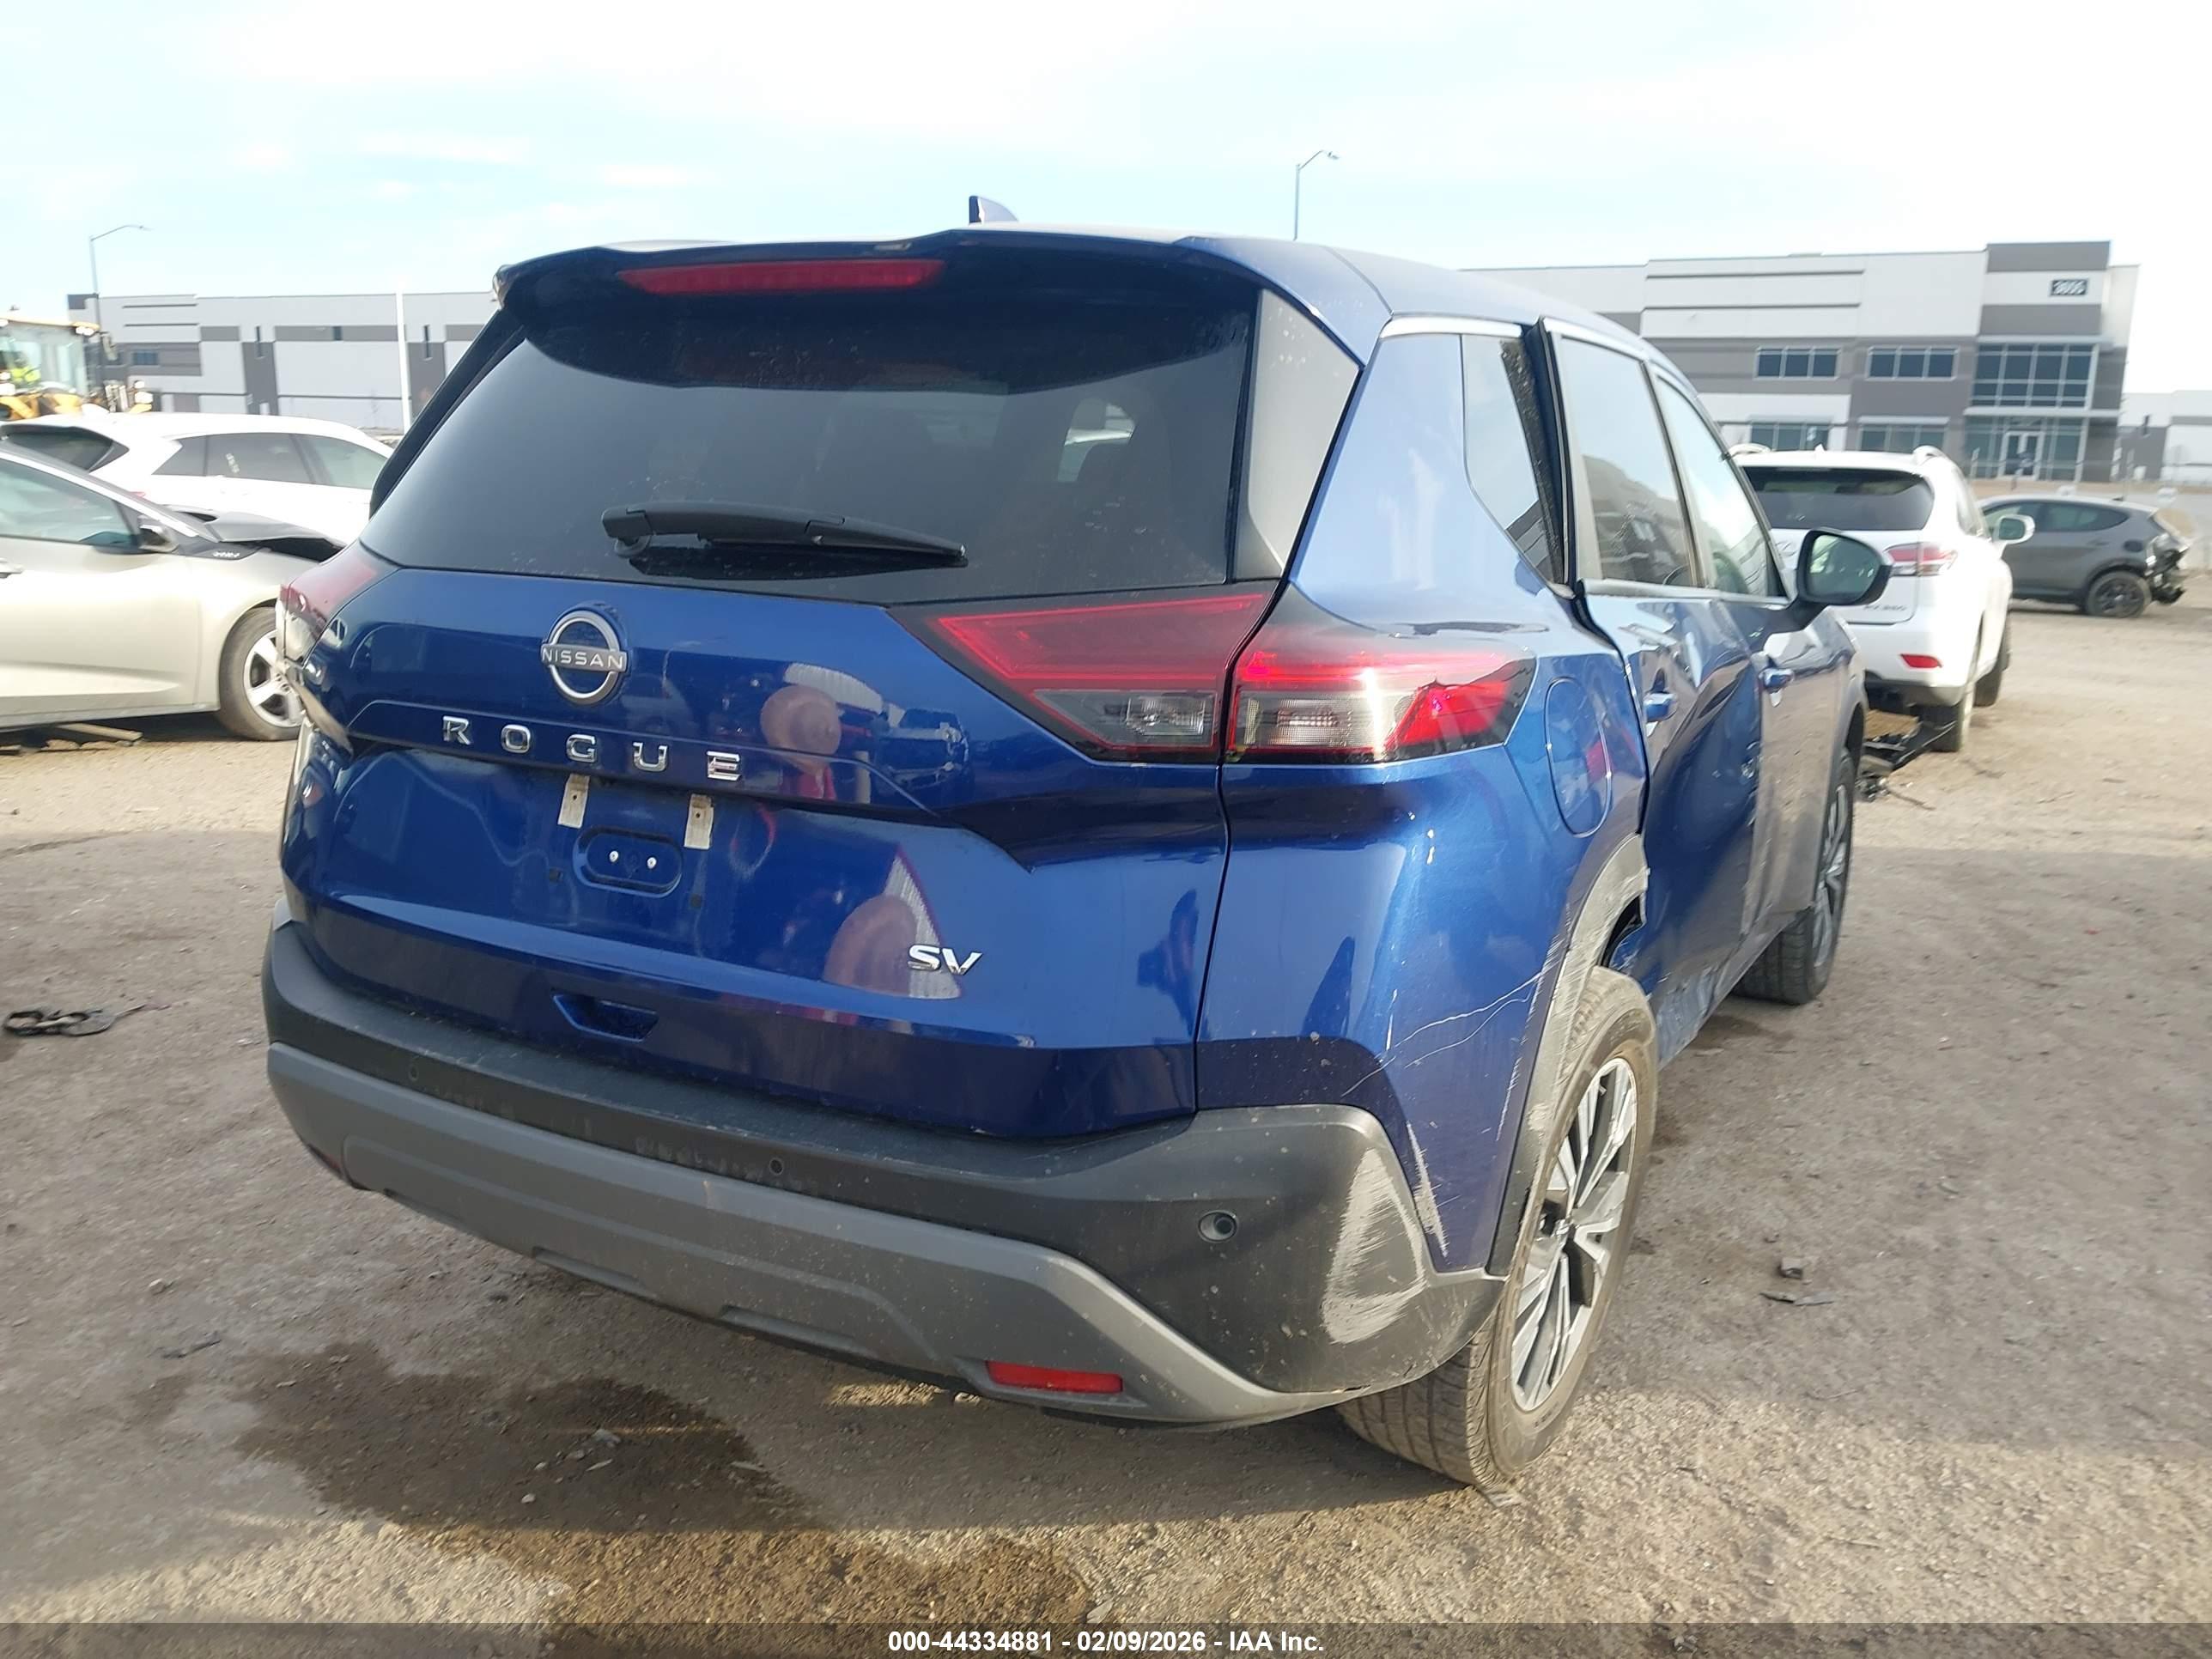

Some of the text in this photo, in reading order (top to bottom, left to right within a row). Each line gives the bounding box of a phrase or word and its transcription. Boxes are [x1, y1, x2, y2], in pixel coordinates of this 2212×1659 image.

[542, 647, 623, 669] NISSAN
[442, 715, 742, 781] ROGUE
[908, 945, 983, 975] SV
